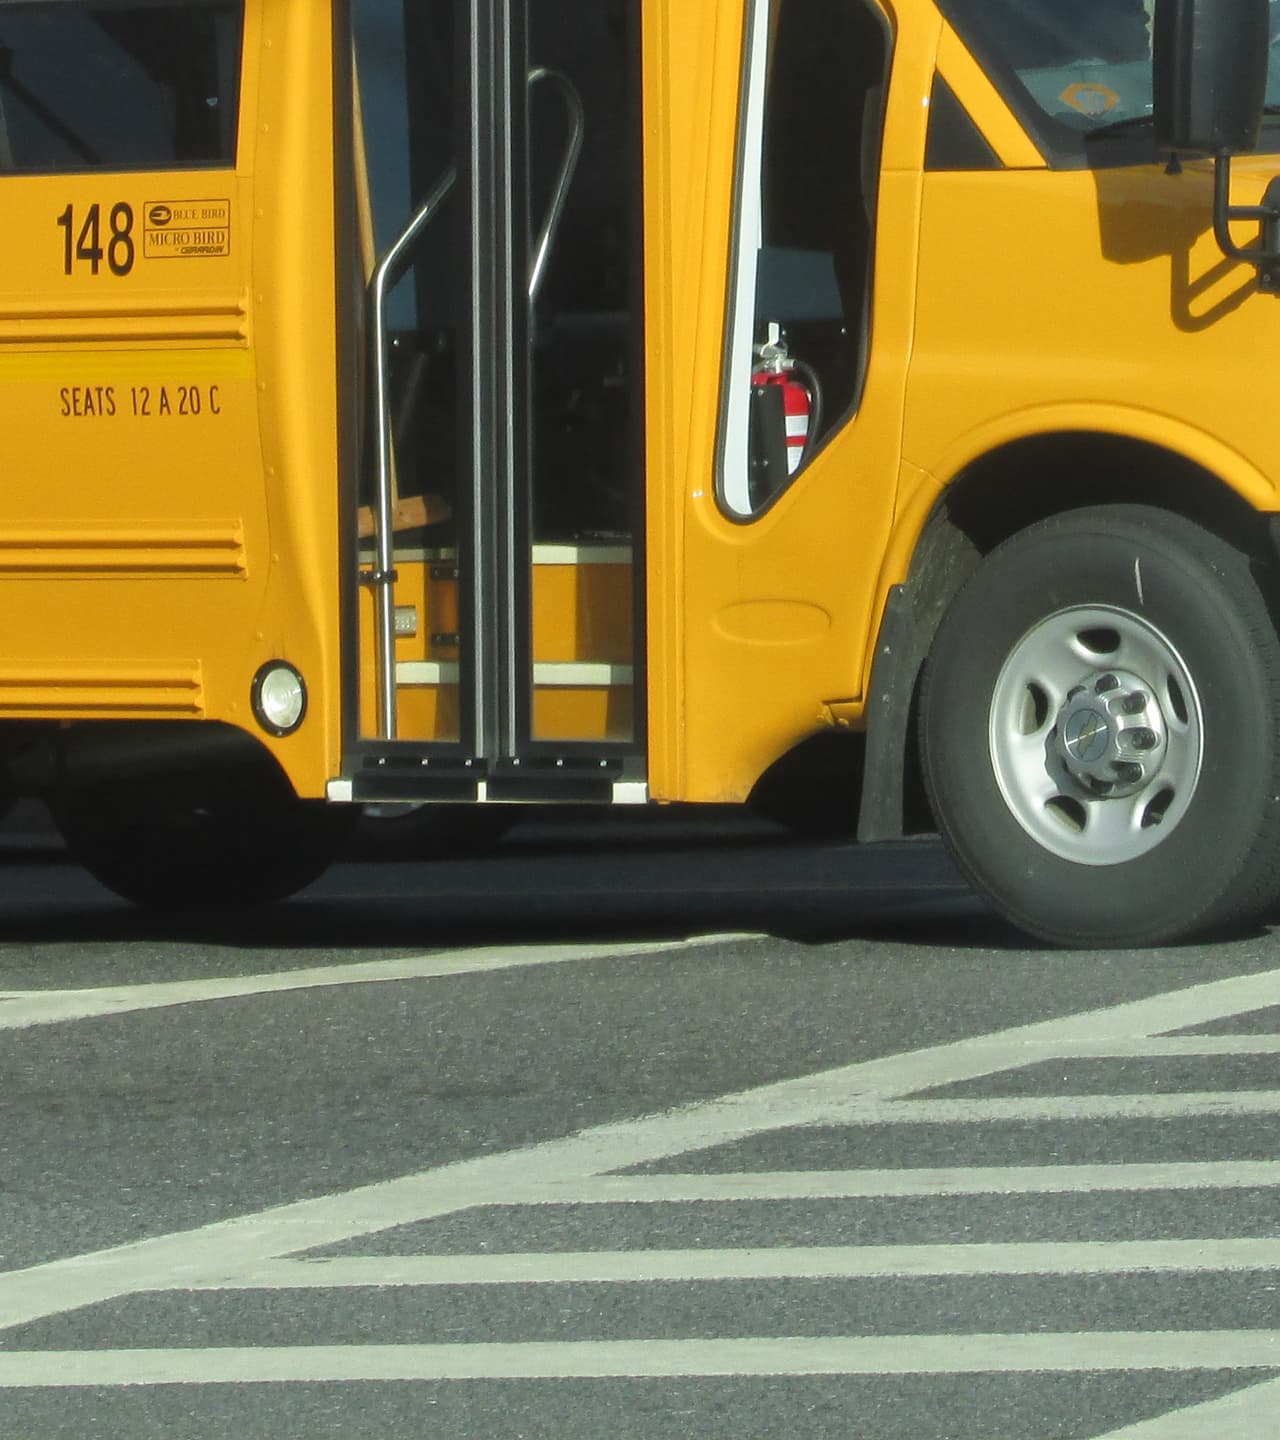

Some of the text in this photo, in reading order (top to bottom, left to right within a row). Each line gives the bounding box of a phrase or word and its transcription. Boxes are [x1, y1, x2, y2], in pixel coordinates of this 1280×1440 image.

[173, 208, 225, 220] BLUE BIRD
[57, 202, 135, 277] 148
[149, 231, 225, 246] MICRO BIRD
[60, 385, 220, 416] SEATS 12 A 20 C
